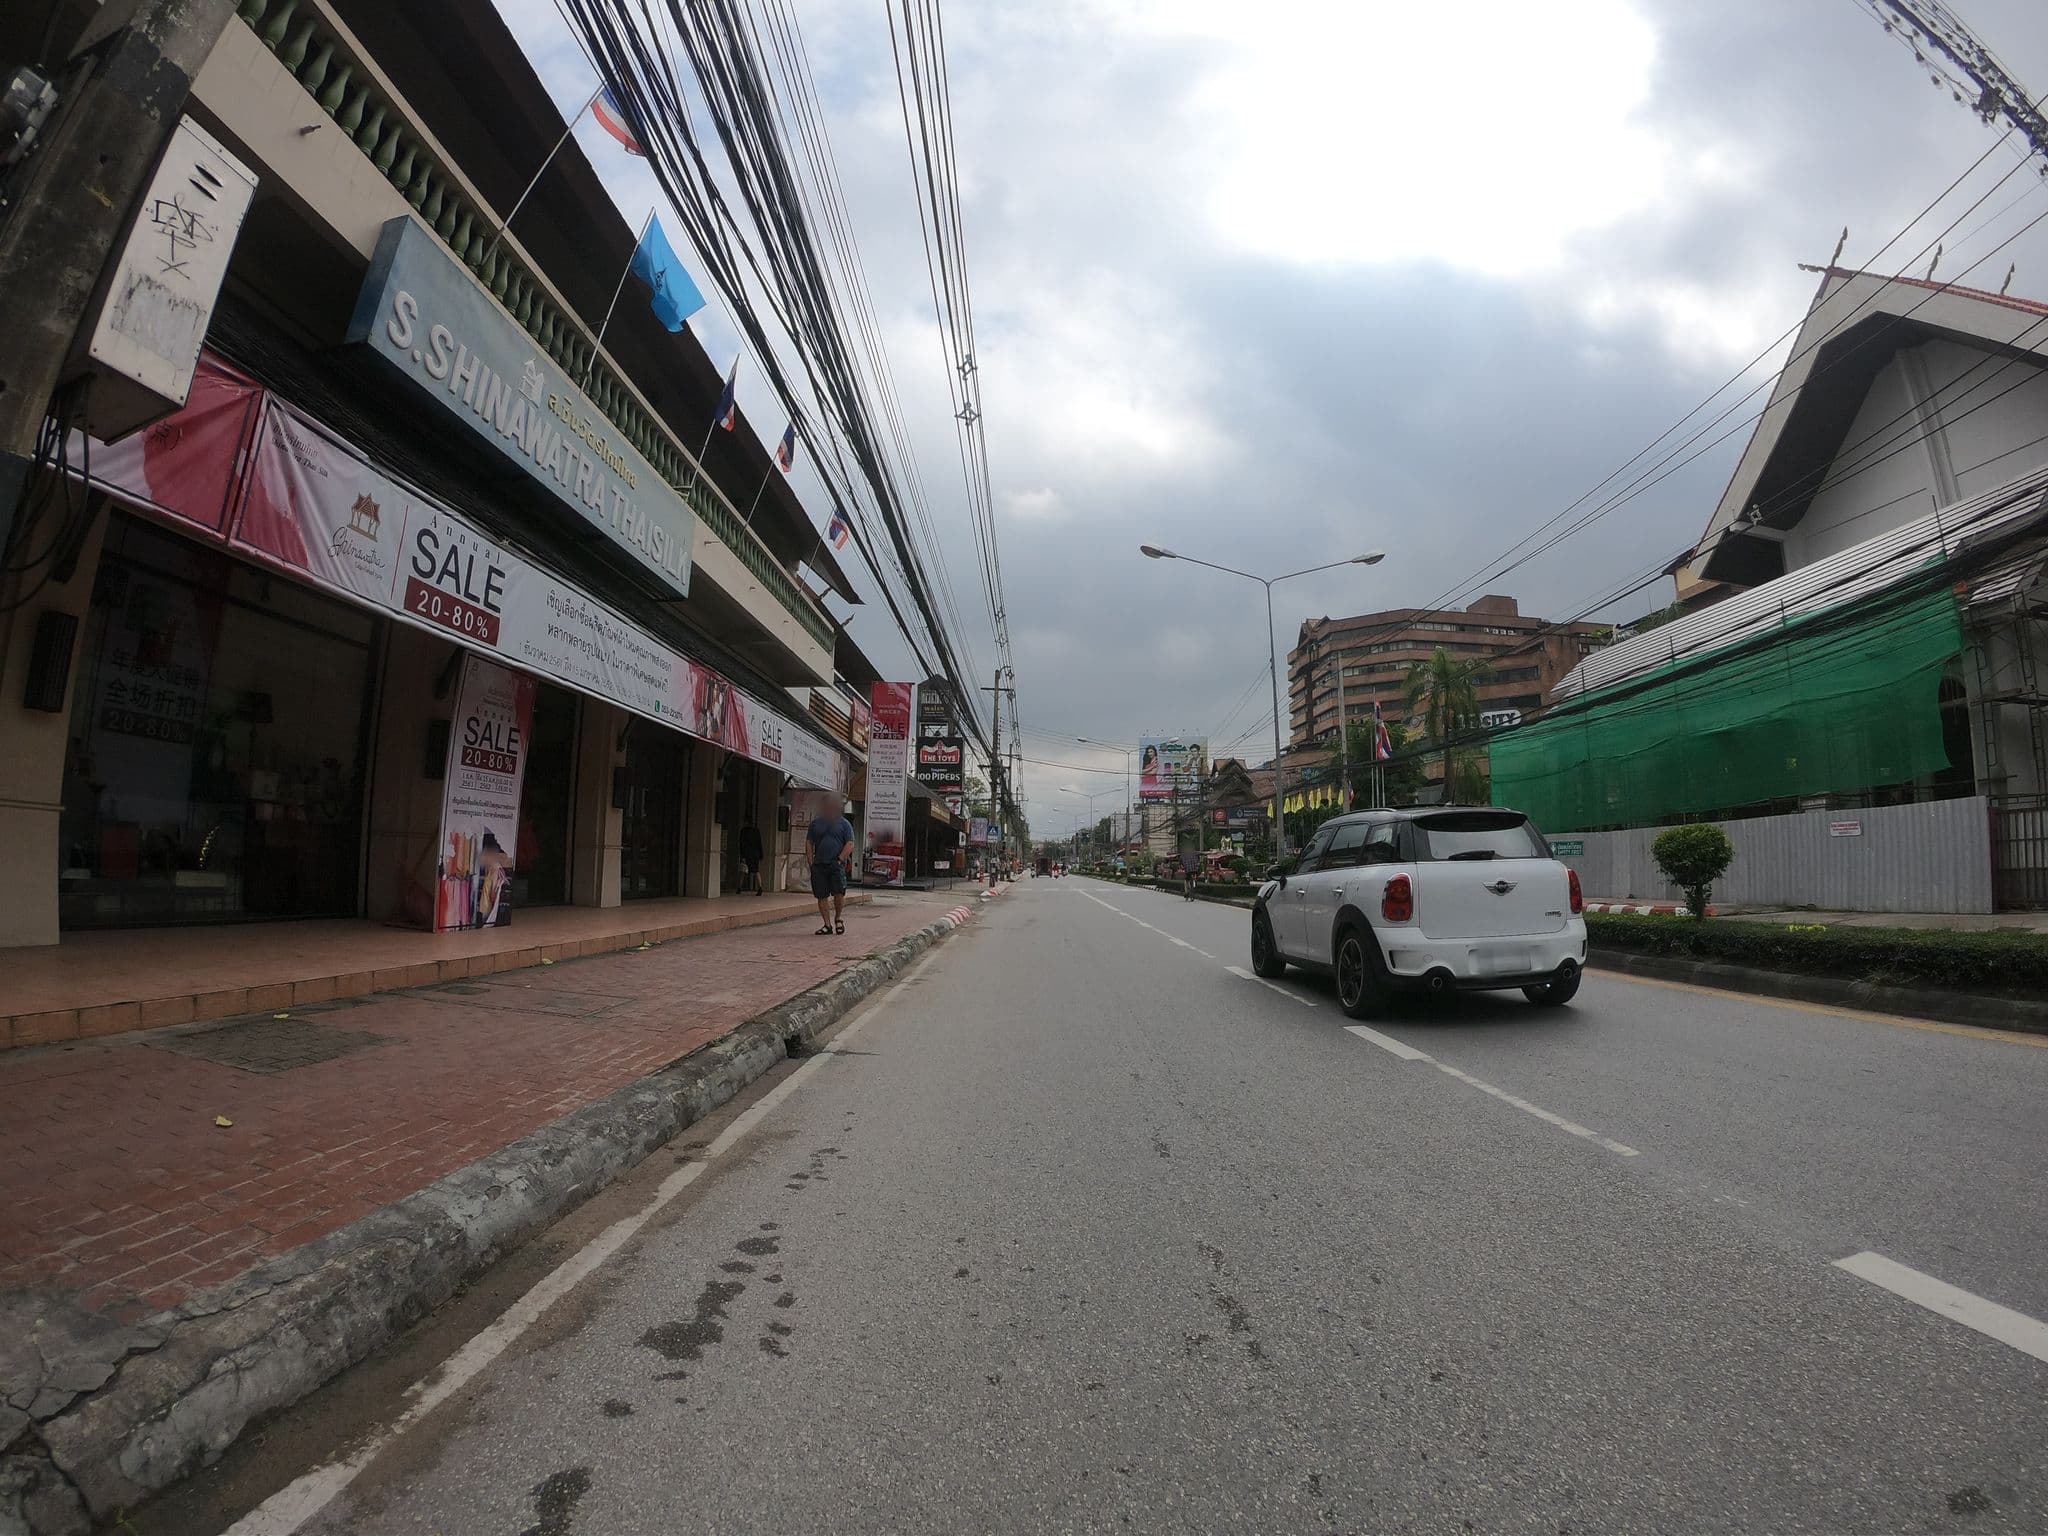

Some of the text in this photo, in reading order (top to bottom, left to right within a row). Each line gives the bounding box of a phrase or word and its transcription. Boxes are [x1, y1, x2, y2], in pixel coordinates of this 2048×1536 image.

[430, 515, 500, 563] Annual
[412, 529, 506, 613] SALE
[416, 590, 489, 639] 20-80%
[105, 677, 197, 719] 全场折扣
[762, 720, 782, 749] SALE
[873, 722, 904, 733] SALE
[1482, 712, 1516, 728] CITY
[464, 716, 520, 755] SALE
[466, 749, 513, 772] 20-80%
[923, 754, 938, 762] THE
[917, 772, 960, 781] 100 PIPERS
